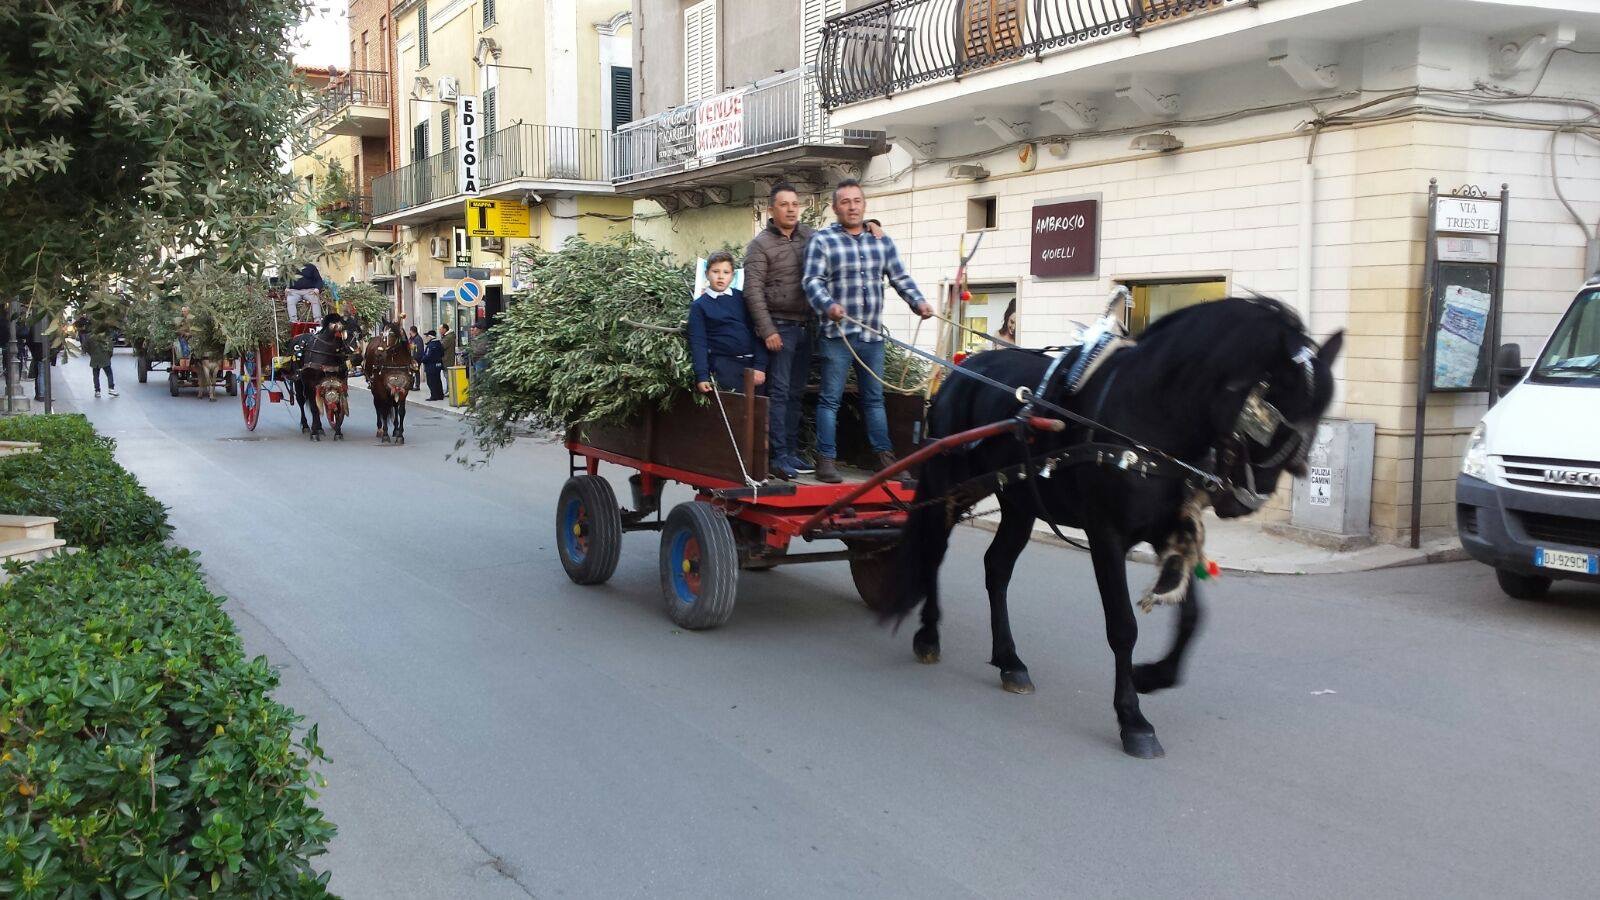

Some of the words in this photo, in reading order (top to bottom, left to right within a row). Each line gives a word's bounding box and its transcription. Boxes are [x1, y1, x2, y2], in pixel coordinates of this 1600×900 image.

[698, 97, 741, 124] VENDE
[463, 100, 477, 192] EDICOLA
[1460, 202, 1477, 214] VIA
[1035, 214, 1085, 234] AMBROSIO
[1446, 217, 1489, 229] TRIESTE
[1041, 246, 1075, 261] GIOIELLI
[1311, 468, 1330, 476] PULIZIA
[1544, 469, 1600, 486] IVECO
[1311, 477, 1330, 485] CAMINI
